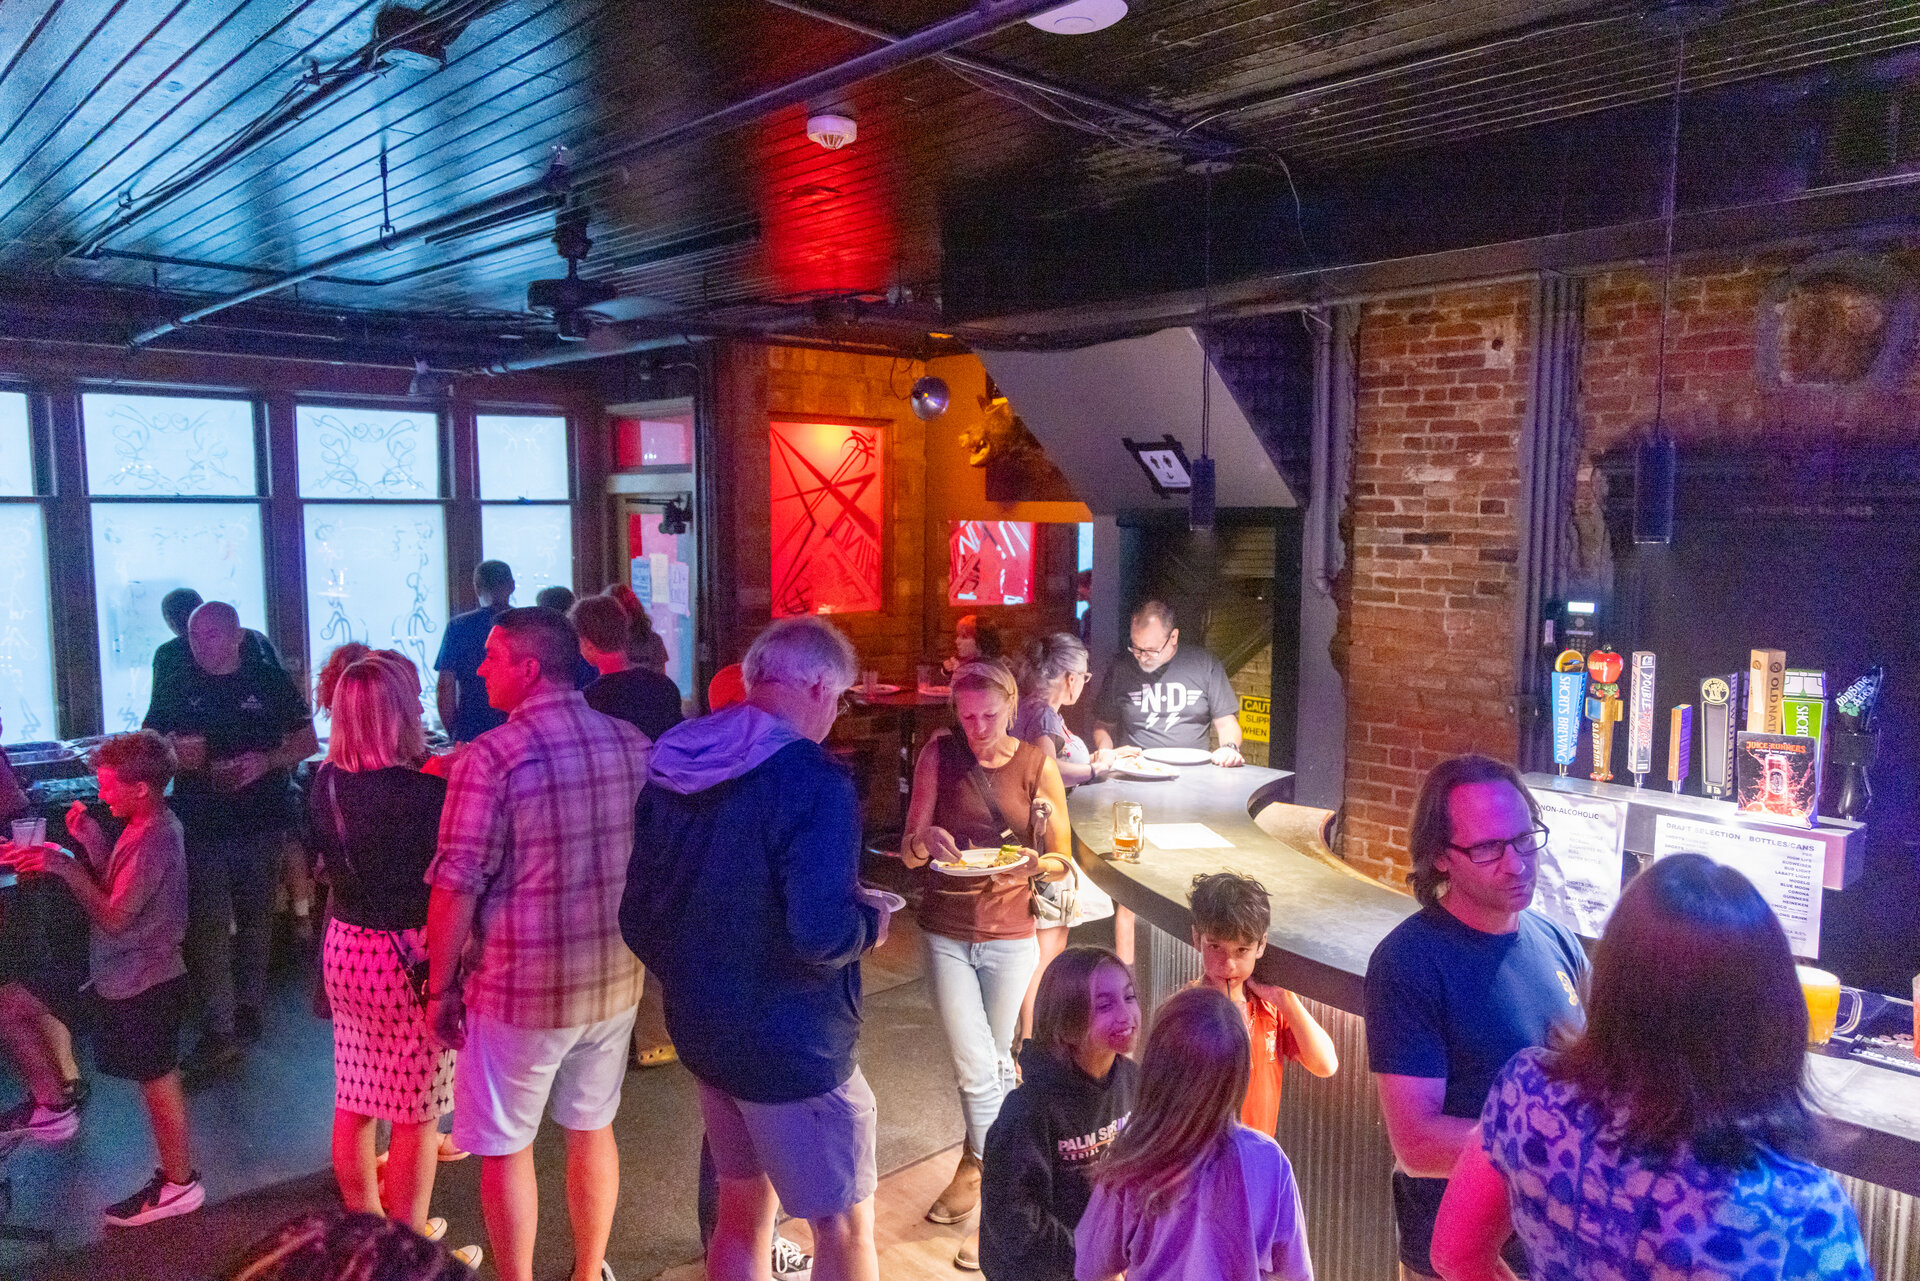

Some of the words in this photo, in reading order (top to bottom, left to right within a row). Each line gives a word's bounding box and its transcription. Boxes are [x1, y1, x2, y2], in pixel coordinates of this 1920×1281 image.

[1640, 671, 1653, 711] DOUBLE
[1729, 674, 1738, 720] BREW
[1769, 677, 1780, 704] OLD
[1241, 726, 1267, 737] WHEN
[1556, 716, 1569, 762] BREWING
[1637, 711, 1651, 751] FUDGE
[1745, 741, 1769, 750] JUICE
[1769, 743, 1807, 755] RUNNERS
[1541, 804, 1600, 820] NON-ALCOHOLIC
[1666, 822, 1692, 832] DRAFT
[1694, 827, 1741, 840] SELECTION
[1782, 894, 1809, 902] GUINNESS
[1787, 890, 1810, 898] CORONA
[1782, 900, 1809, 908] HEINEKEN
[1058, 1132, 1096, 1152] PALM
[1063, 1147, 1099, 1160] AERIAL
